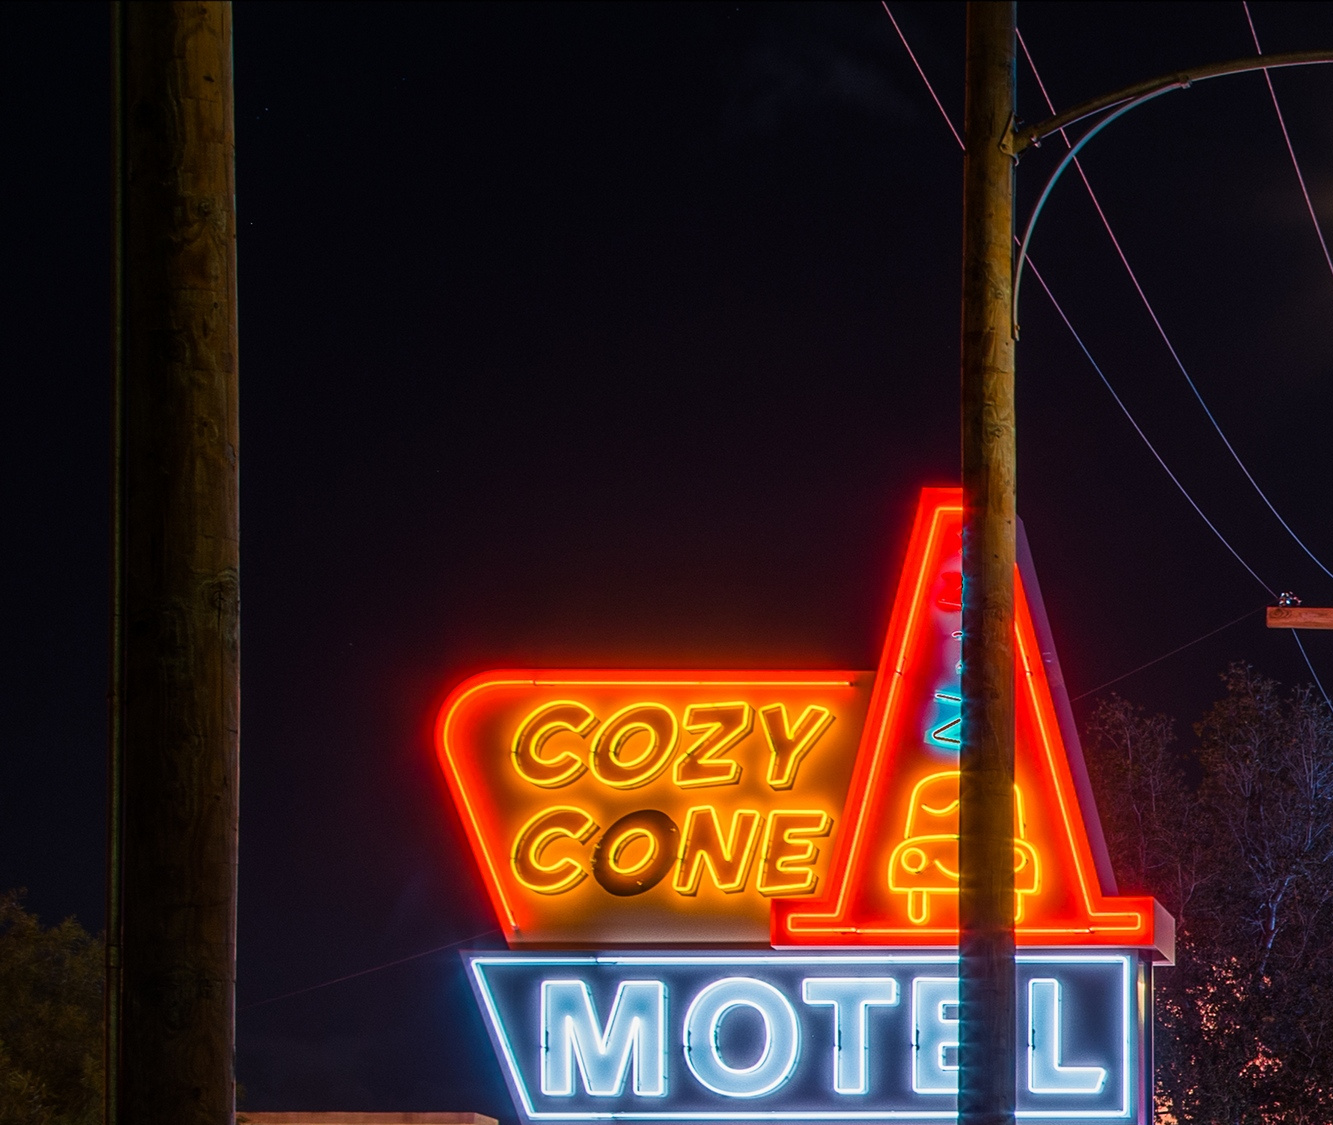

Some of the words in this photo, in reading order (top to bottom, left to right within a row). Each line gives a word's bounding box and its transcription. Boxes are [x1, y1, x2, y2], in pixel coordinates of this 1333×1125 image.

[511, 699, 836, 789] COZY
[509, 804, 834, 896] CONE
[539, 976, 1106, 1098] MOTEL
